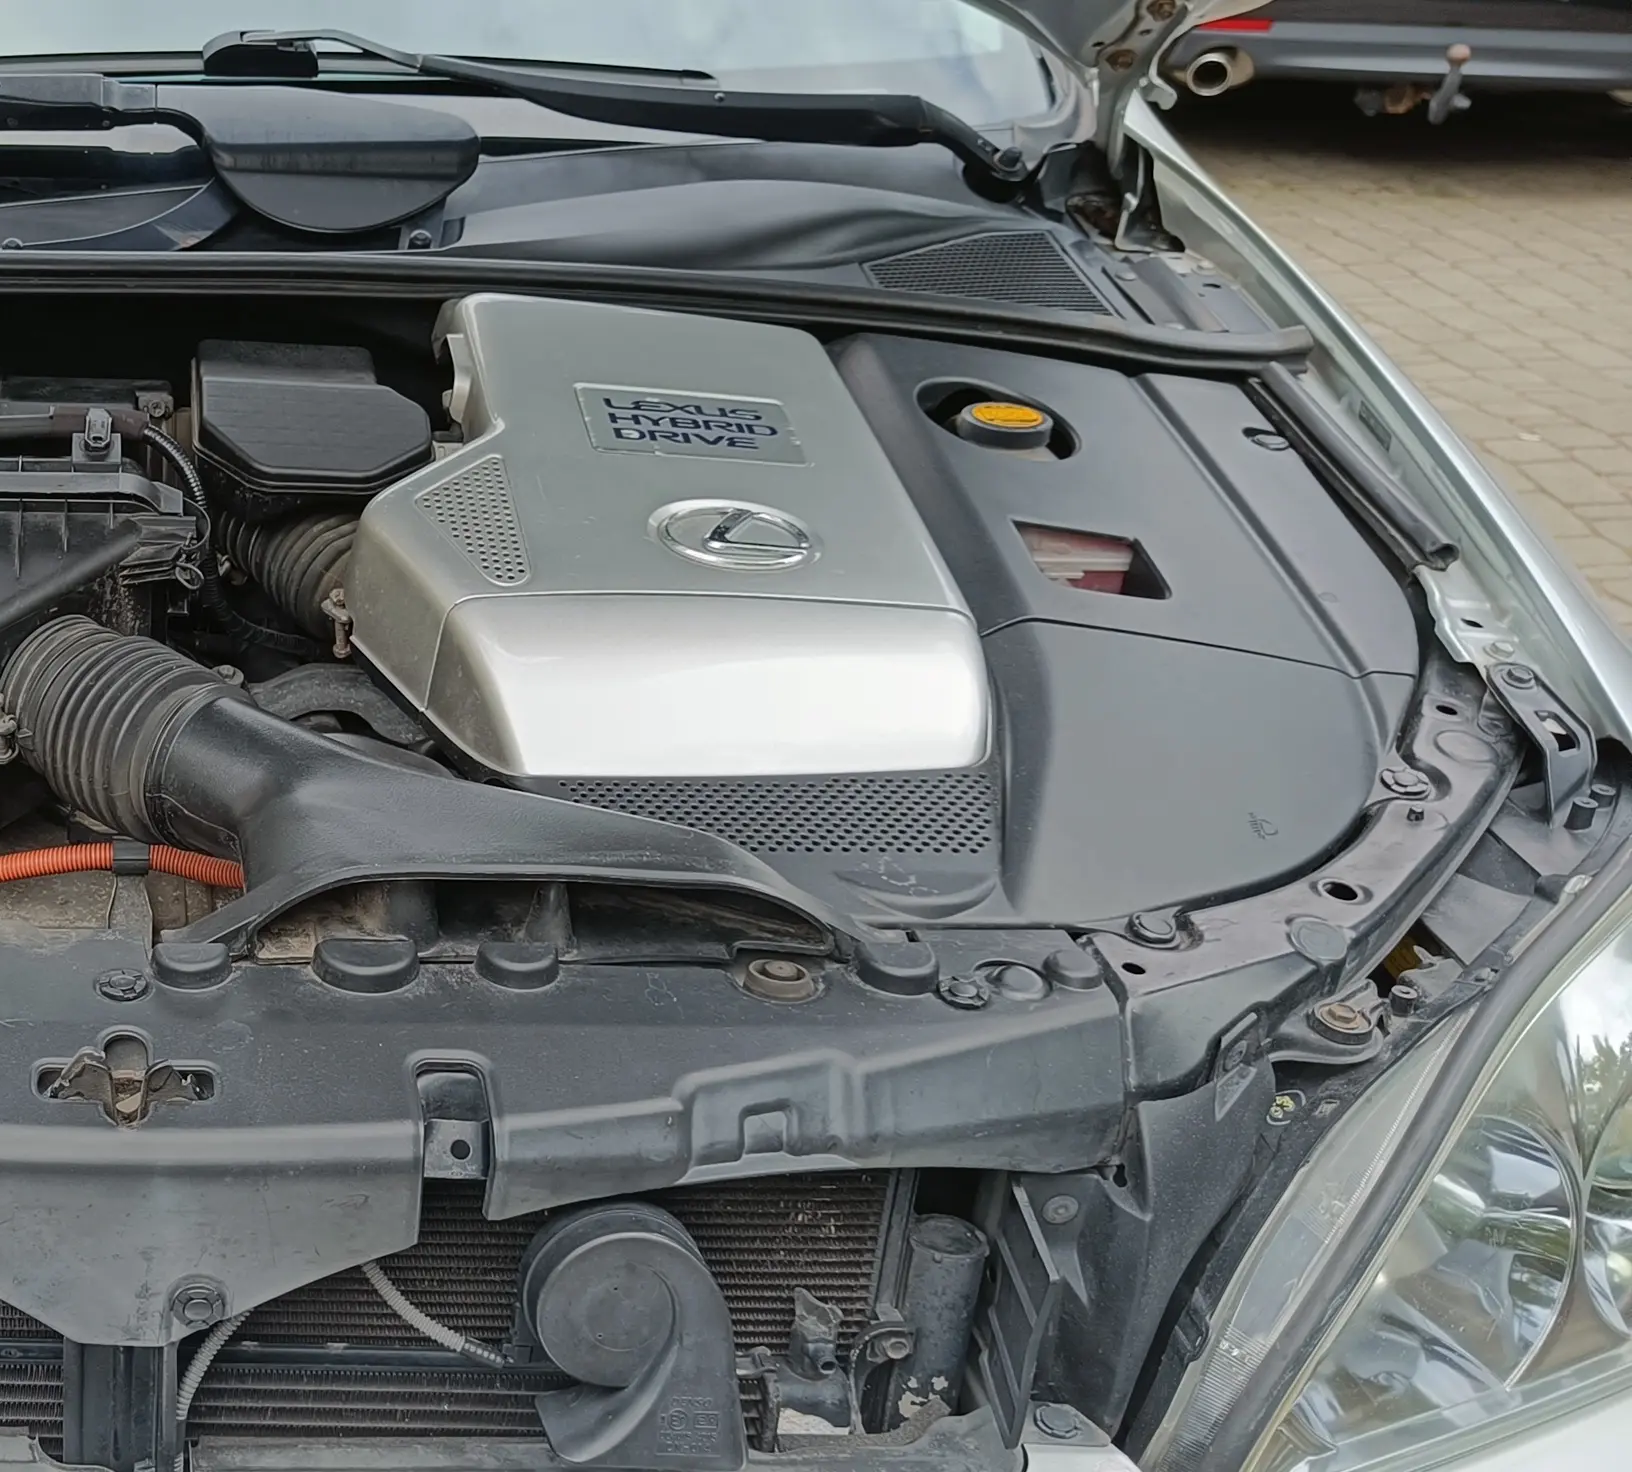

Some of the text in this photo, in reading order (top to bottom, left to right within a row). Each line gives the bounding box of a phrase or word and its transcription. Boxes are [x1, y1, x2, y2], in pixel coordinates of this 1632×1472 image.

[603, 398, 762, 421] LEXUS
[608, 412, 778, 436] HYBRID
[612, 427, 760, 449] DRIVE
